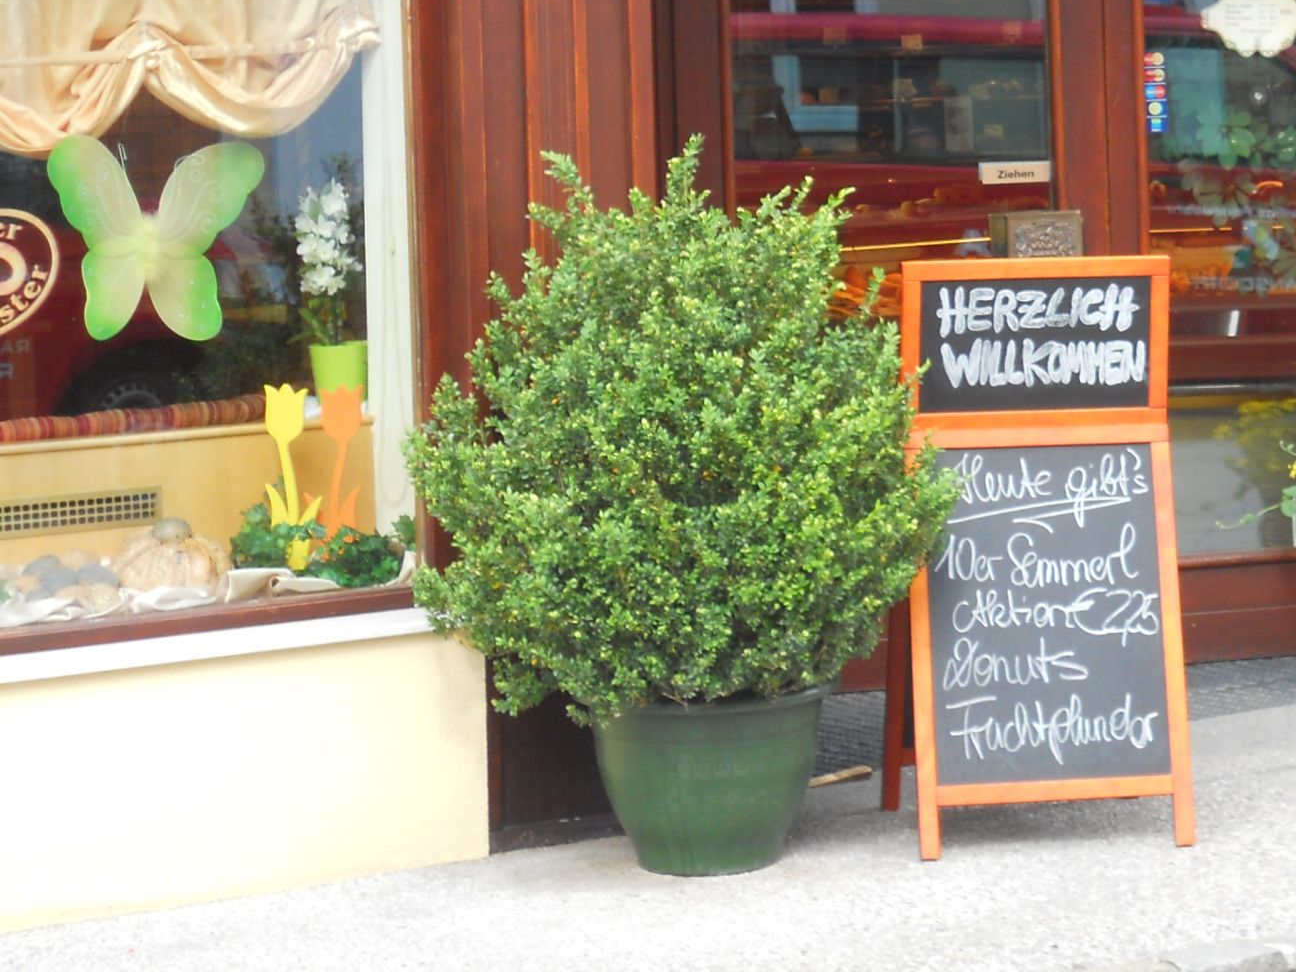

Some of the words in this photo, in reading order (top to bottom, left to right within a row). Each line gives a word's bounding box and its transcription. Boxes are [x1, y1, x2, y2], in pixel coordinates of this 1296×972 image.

[997, 169, 1035, 179] Ziehen
[936, 283, 1141, 338] HERZLICH
[940, 338, 1147, 389] WILLKOMMEN
[953, 453, 1052, 505] Heute
[934, 534, 1004, 584] 10er
[943, 636, 1089, 691] Donuts
